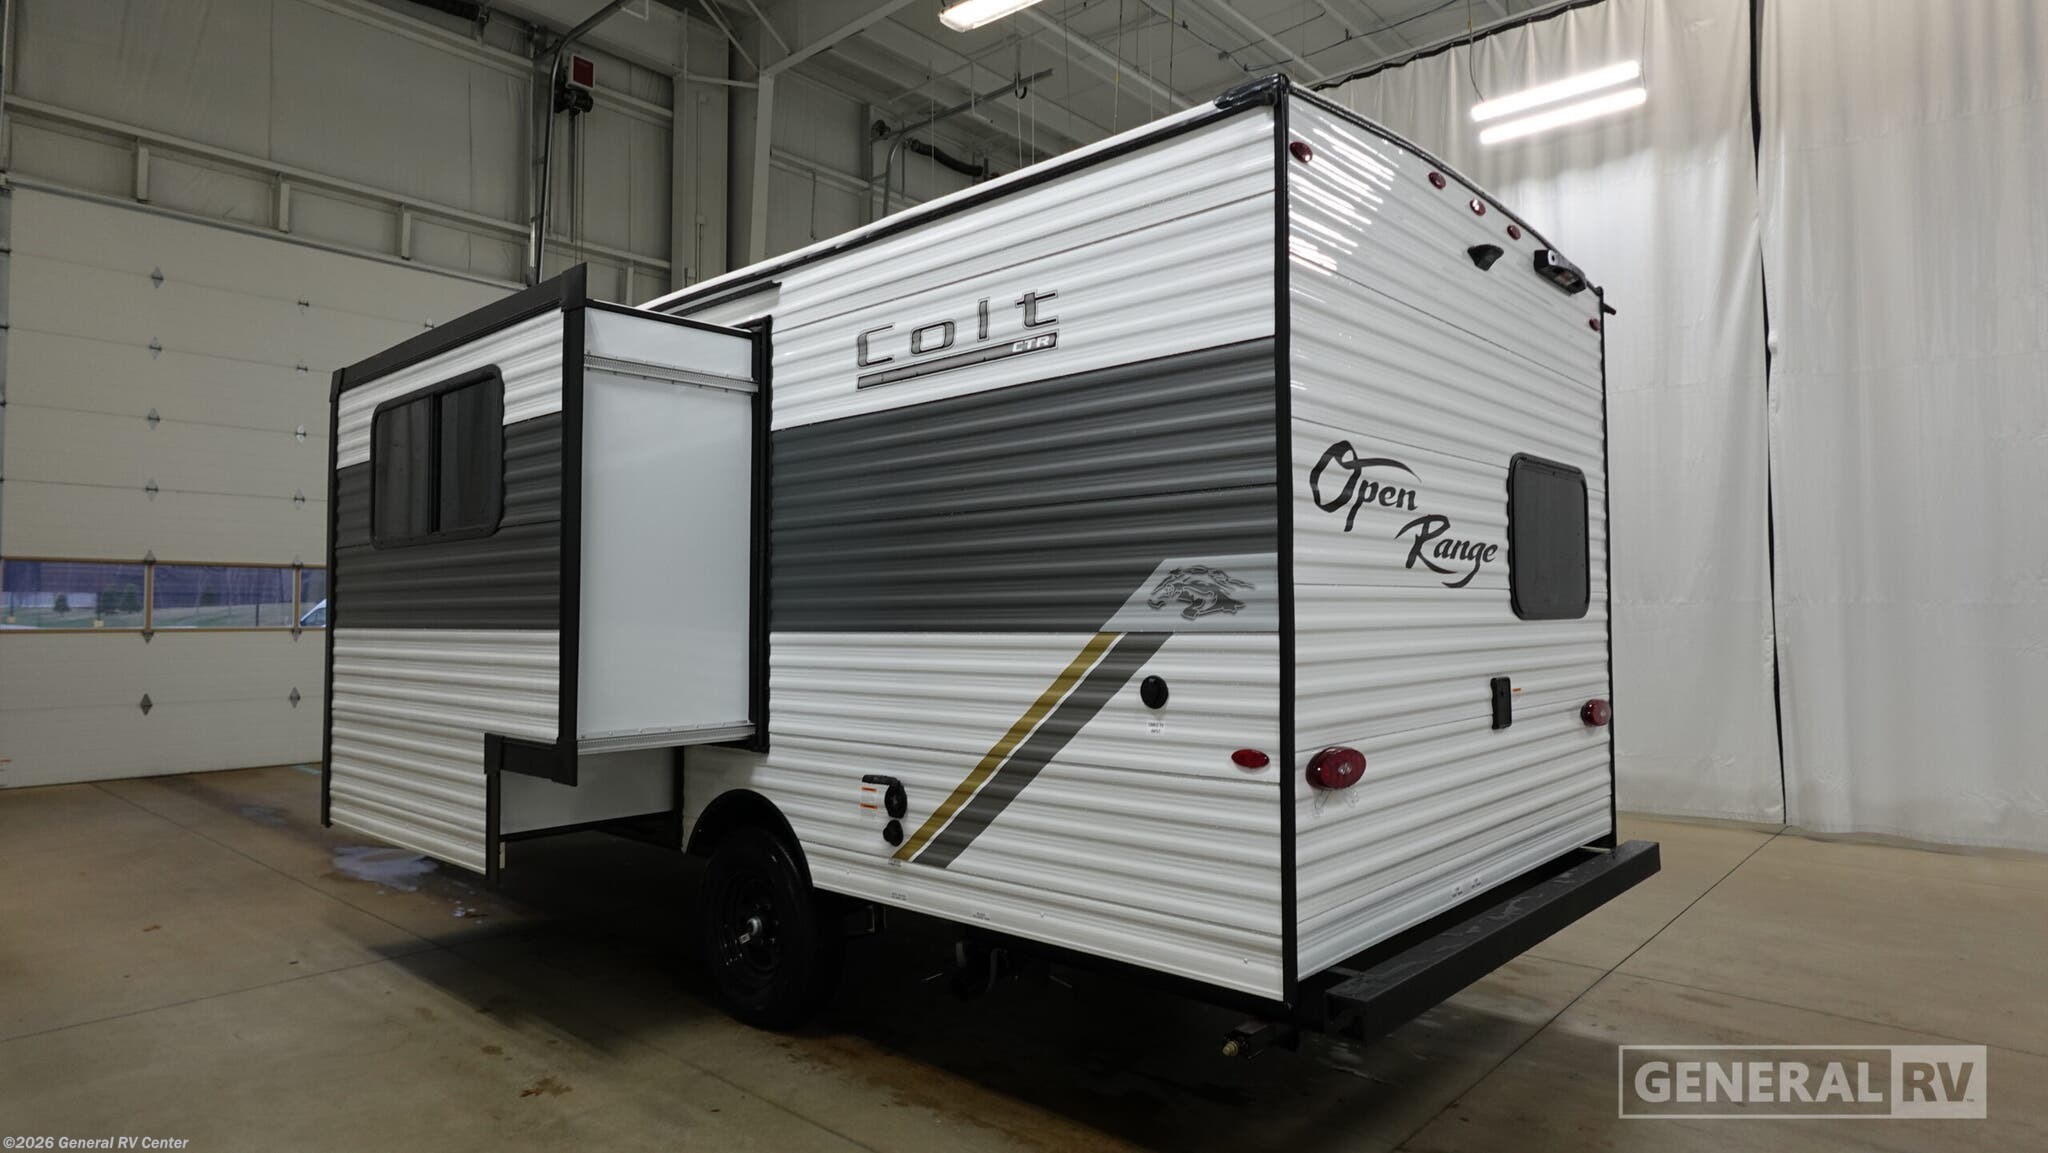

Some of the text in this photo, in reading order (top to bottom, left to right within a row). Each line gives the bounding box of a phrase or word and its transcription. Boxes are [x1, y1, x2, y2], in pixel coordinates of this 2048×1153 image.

[857, 290, 1058, 367] Colt
[1011, 336, 1050, 353] CTR
[1309, 440, 1422, 532] Open
[1393, 514, 1498, 588] Range
